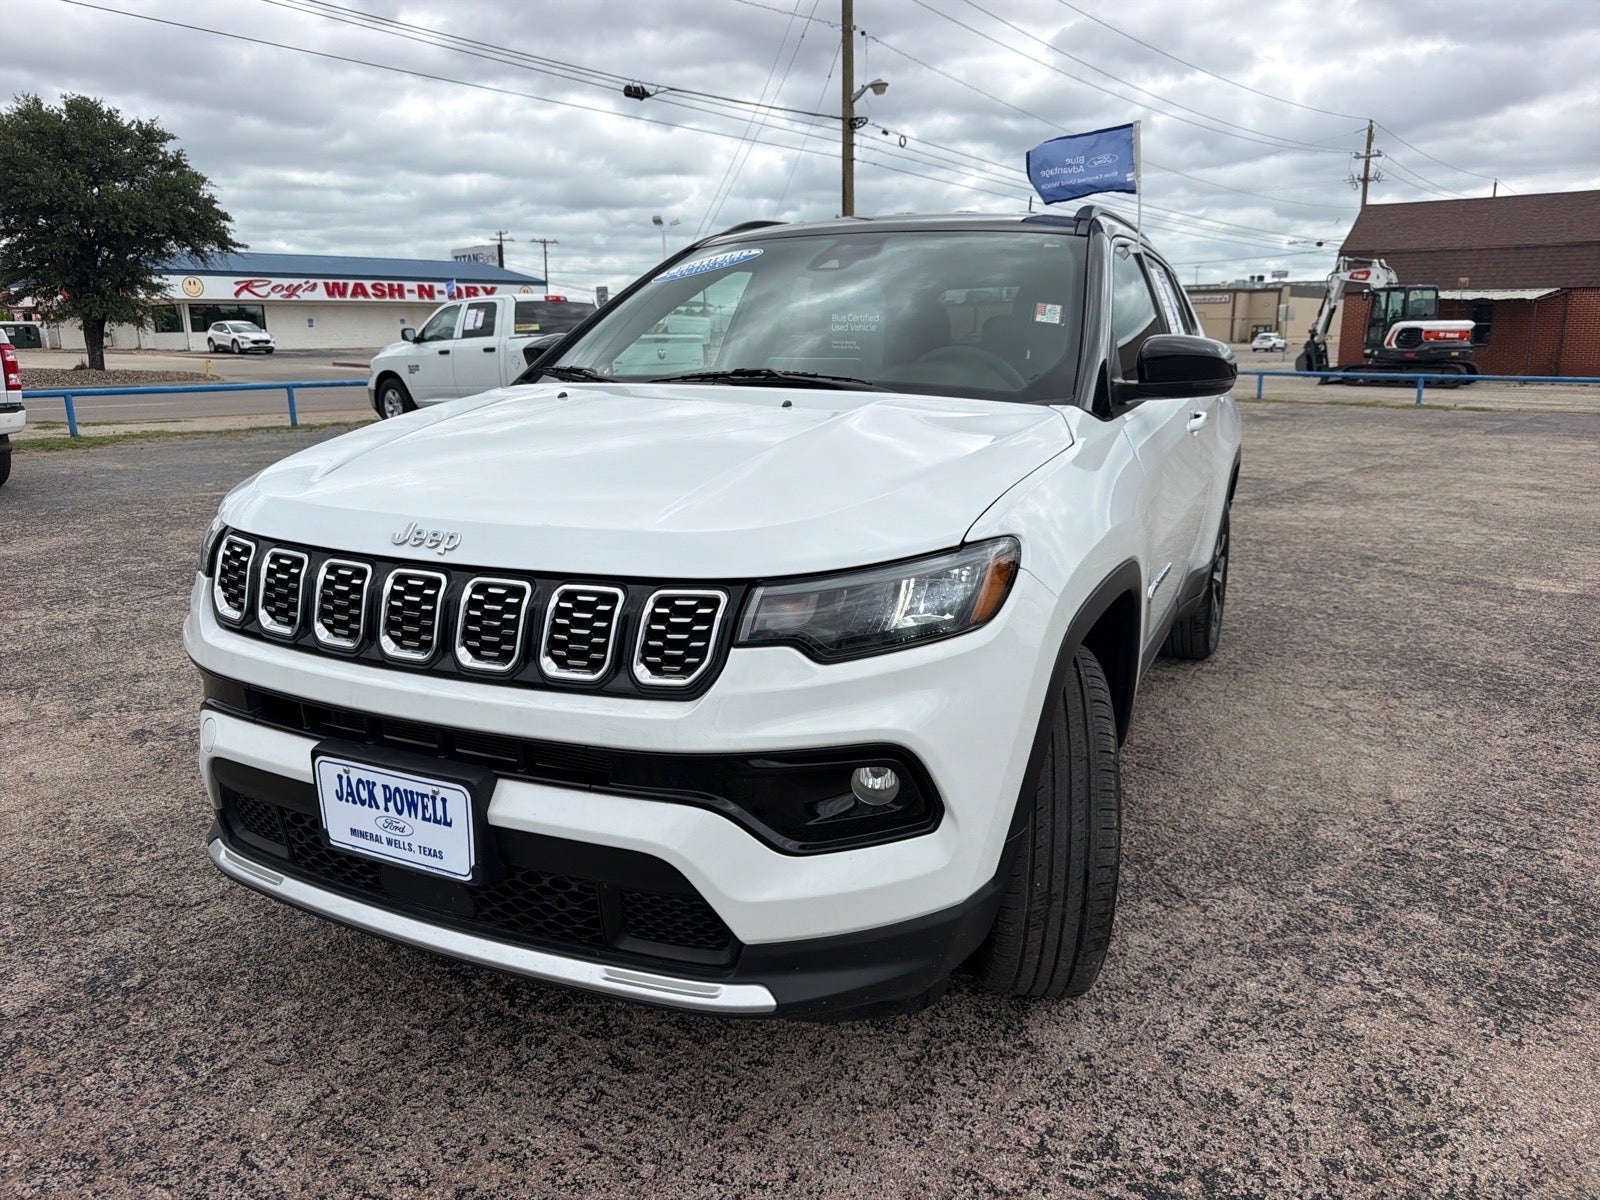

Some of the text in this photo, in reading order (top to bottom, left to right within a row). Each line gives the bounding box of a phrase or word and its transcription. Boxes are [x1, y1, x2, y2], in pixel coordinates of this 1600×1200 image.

[233, 279, 318, 299] Roy's
[831, 312, 880, 322] Blue Certified
[831, 322, 877, 331] Used Vehicle
[391, 522, 462, 556] Jeep
[335, 774, 453, 828] JACK POWELL
[380, 817, 408, 835] Ford
[350, 827, 444, 860] MINERAL WELLS, TEXAS
